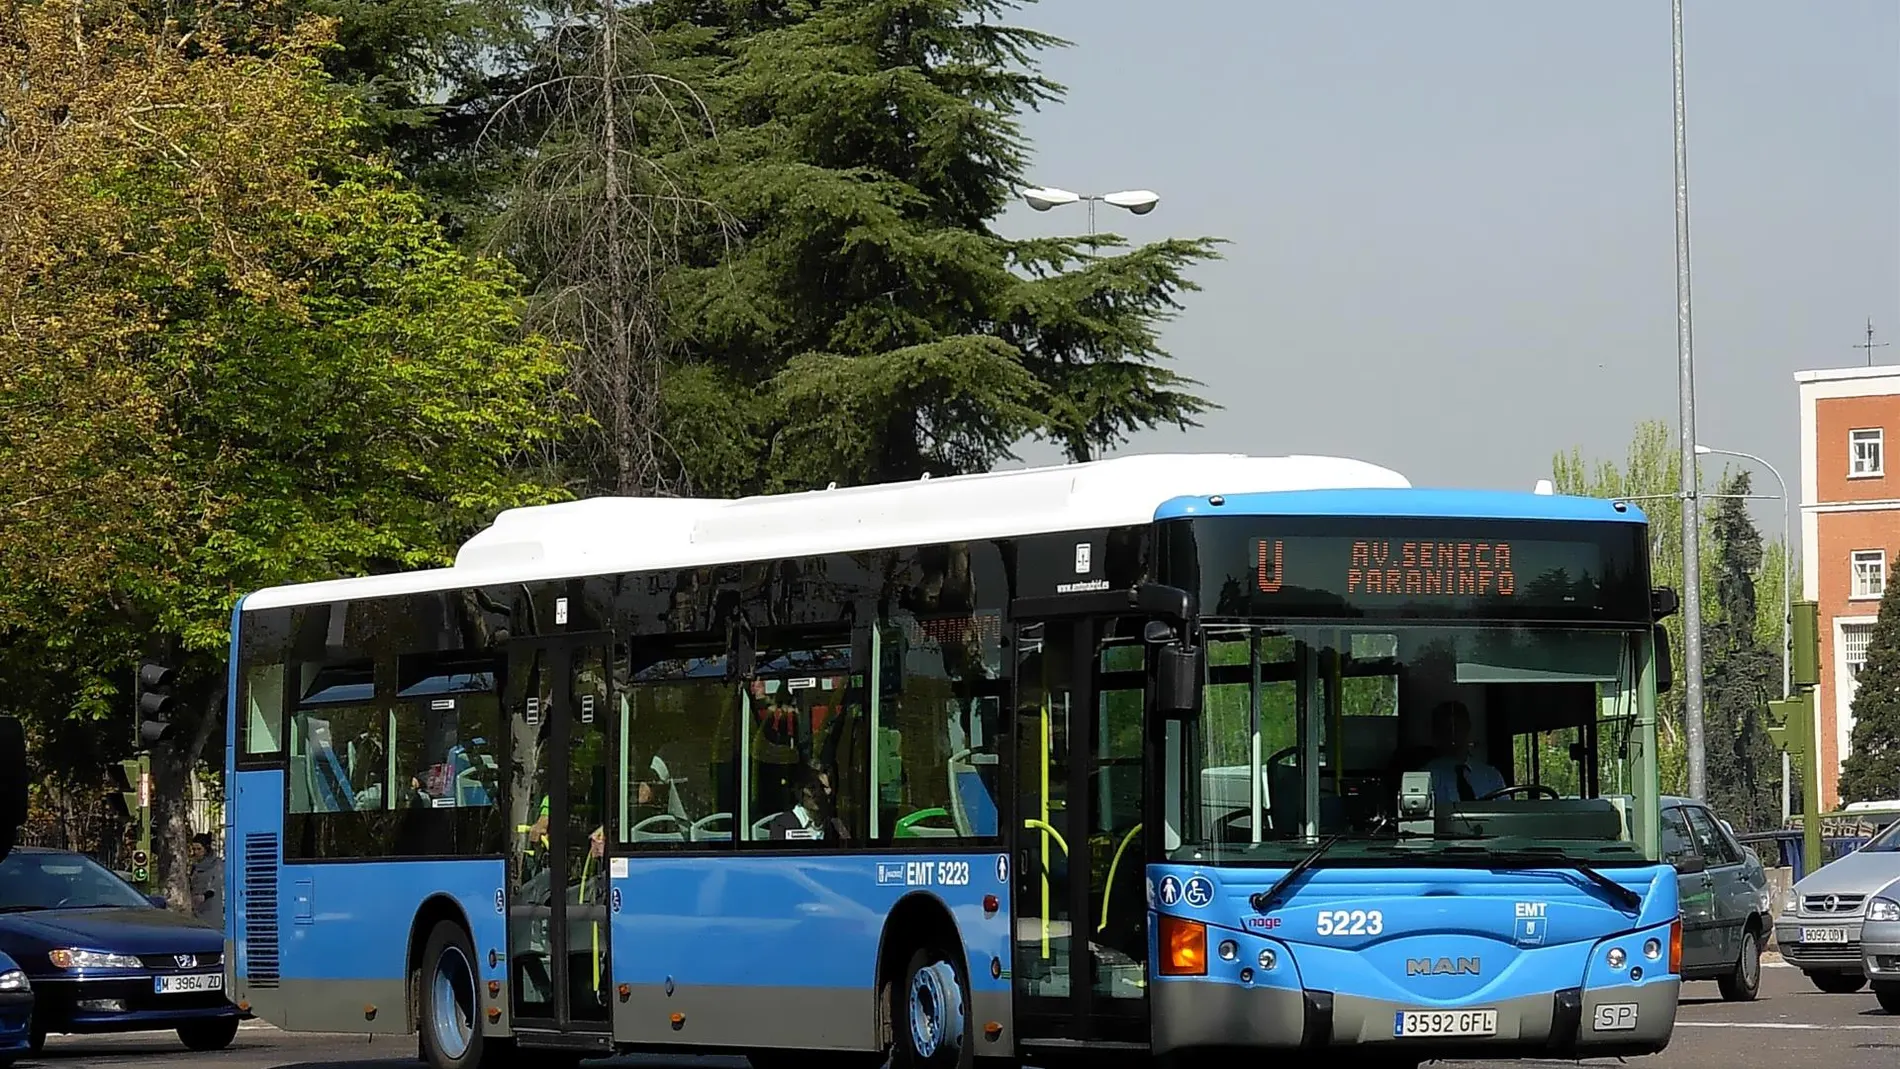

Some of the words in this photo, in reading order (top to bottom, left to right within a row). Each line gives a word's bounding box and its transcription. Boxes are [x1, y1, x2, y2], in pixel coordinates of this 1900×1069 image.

[1352, 542, 1511, 568] AV.SENECA
[1258, 540, 1283, 593] U
[1348, 569, 1515, 595] PARANINFO
[907, 862, 934, 885] EMT
[938, 862, 969, 885] 5223
[1515, 902, 1547, 917] EMT
[1316, 910, 1384, 936] 5223
[1406, 957, 1481, 976] MAN
[175, 976, 202, 990] 3964
[207, 975, 221, 989] ZD
[1406, 1013, 1454, 1032] 3592
[1459, 1012, 1493, 1031] GFL
[1601, 1007, 1632, 1027] SP
